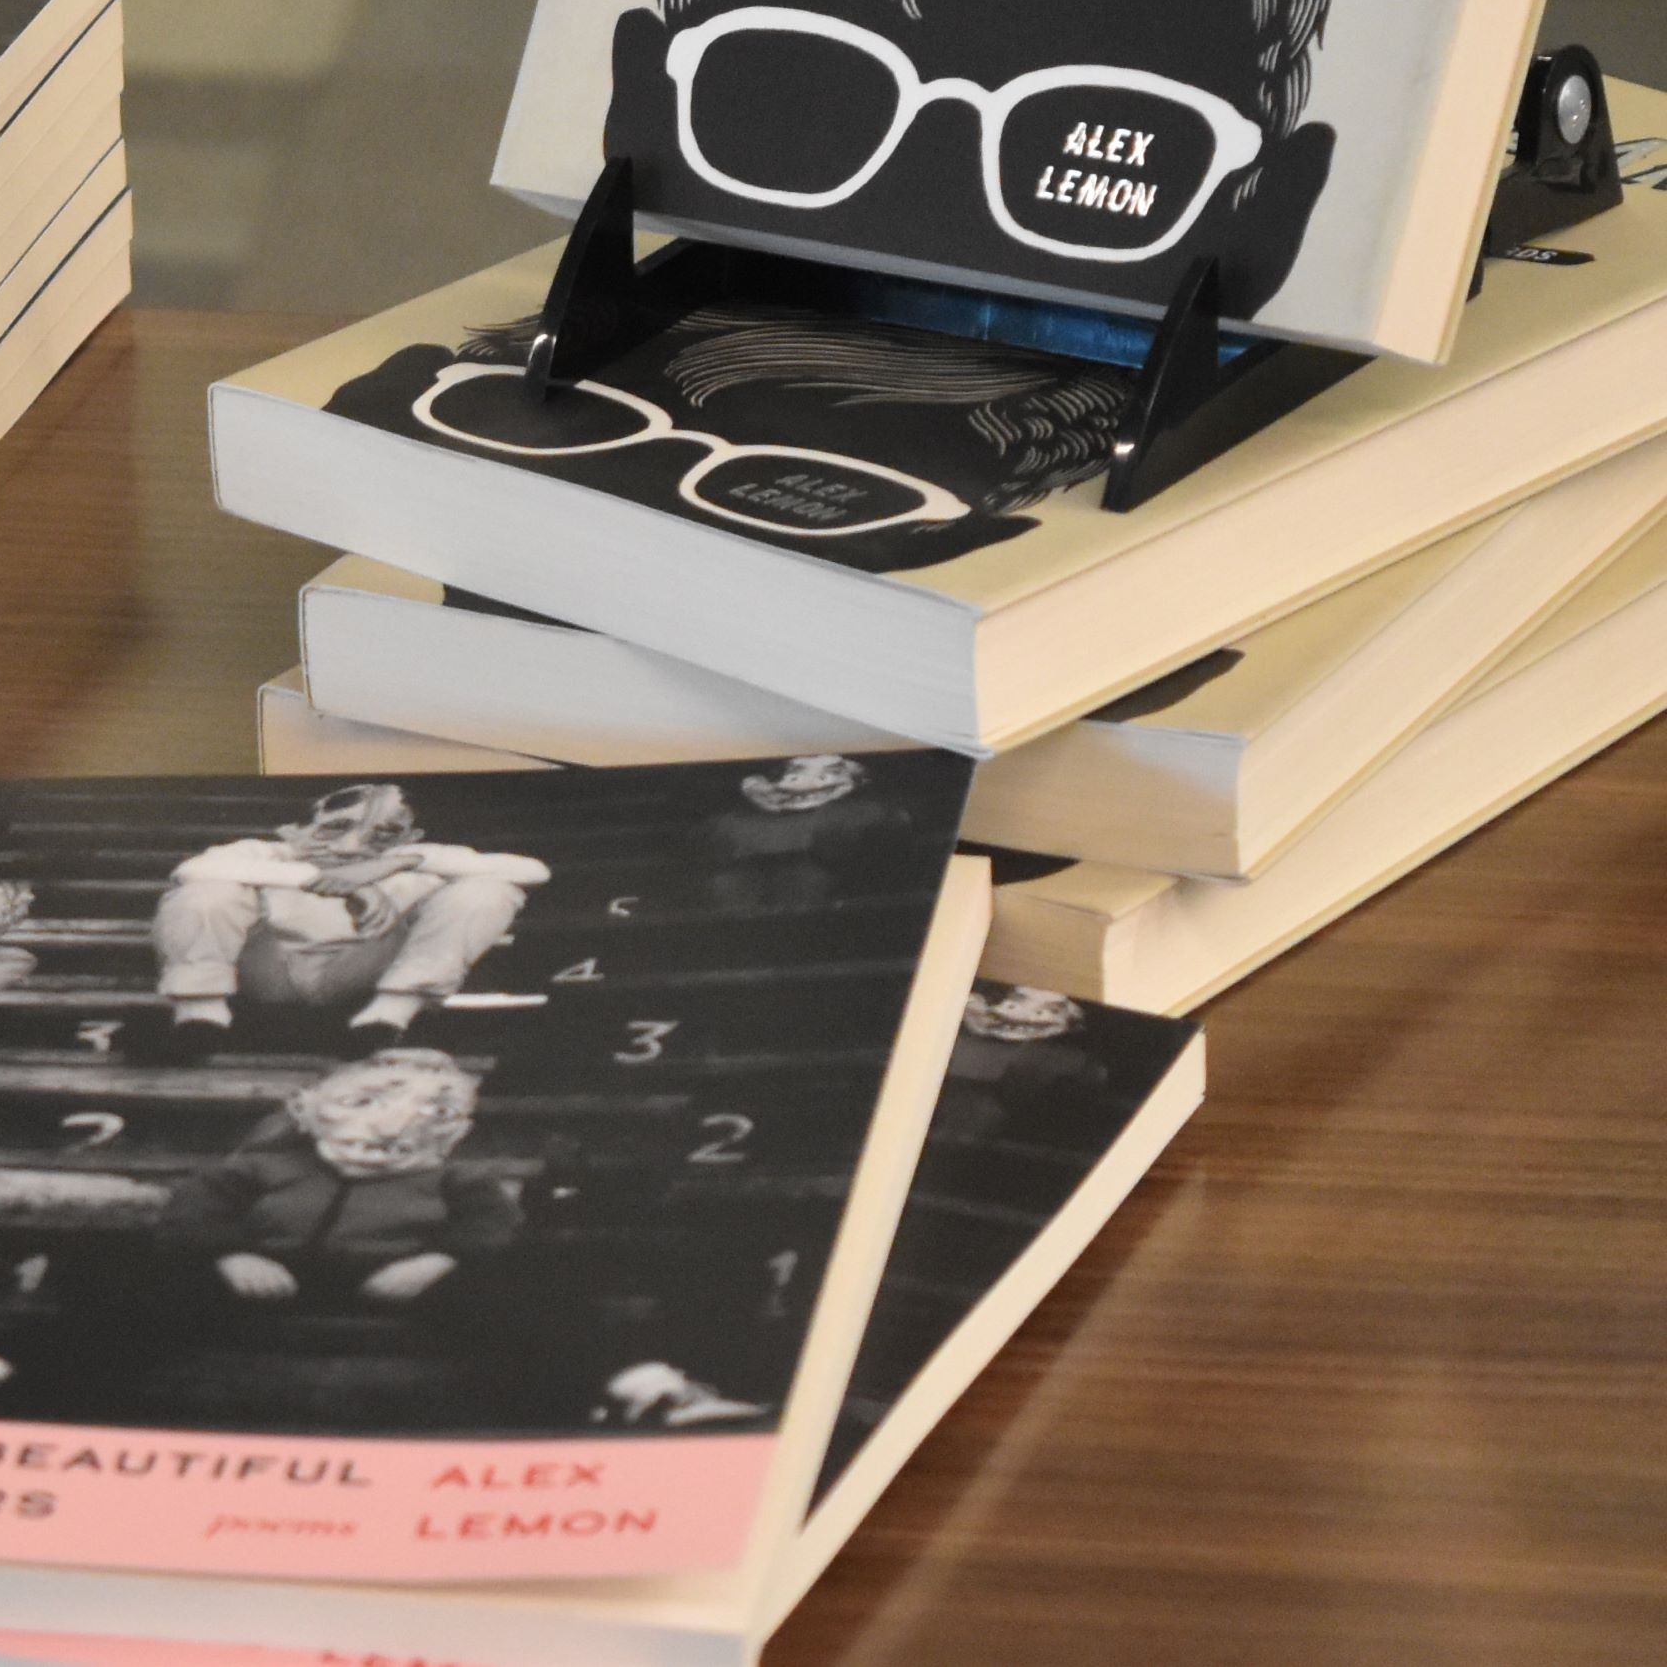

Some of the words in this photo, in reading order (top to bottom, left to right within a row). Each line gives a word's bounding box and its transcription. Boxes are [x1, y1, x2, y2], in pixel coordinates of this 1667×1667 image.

[1062, 121, 1156, 167] ALEX
[1034, 165, 1159, 218] LEMON
[430, 1464, 603, 1489] ALEX
[412, 1510, 658, 1540] LEMON
